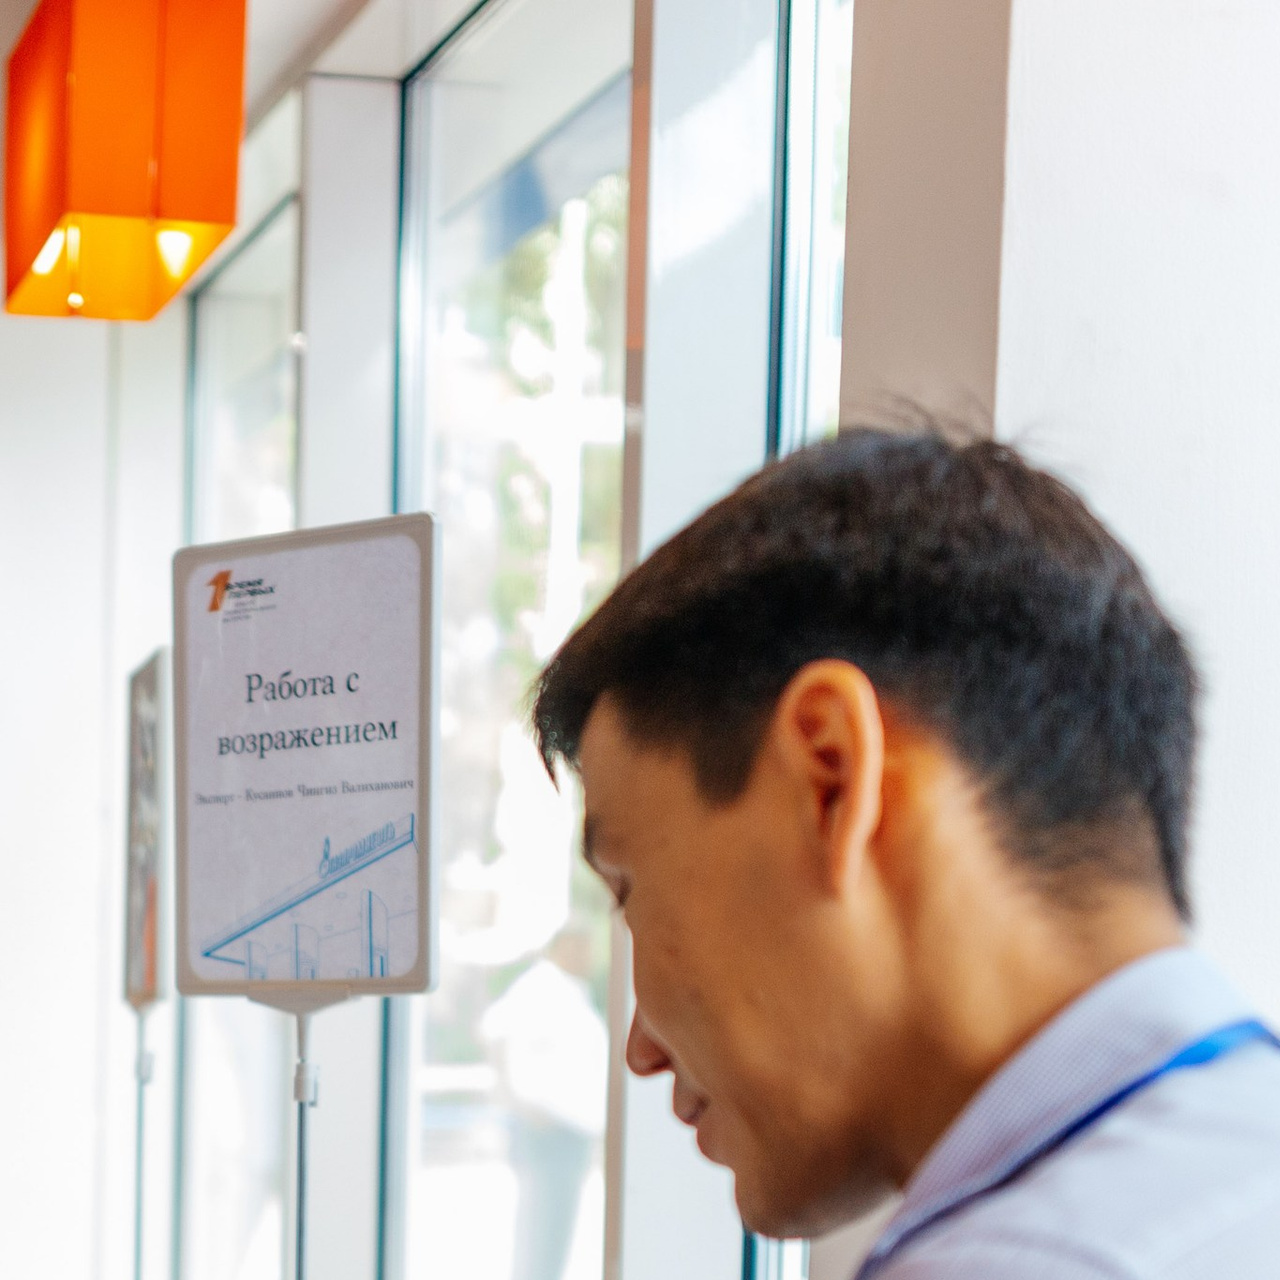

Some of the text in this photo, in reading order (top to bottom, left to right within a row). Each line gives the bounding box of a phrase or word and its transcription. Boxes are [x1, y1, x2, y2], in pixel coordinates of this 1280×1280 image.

[245, 670, 360, 703] Работа с
[217, 720, 398, 759] возражением
[341, 778, 414, 794] Валиханович
